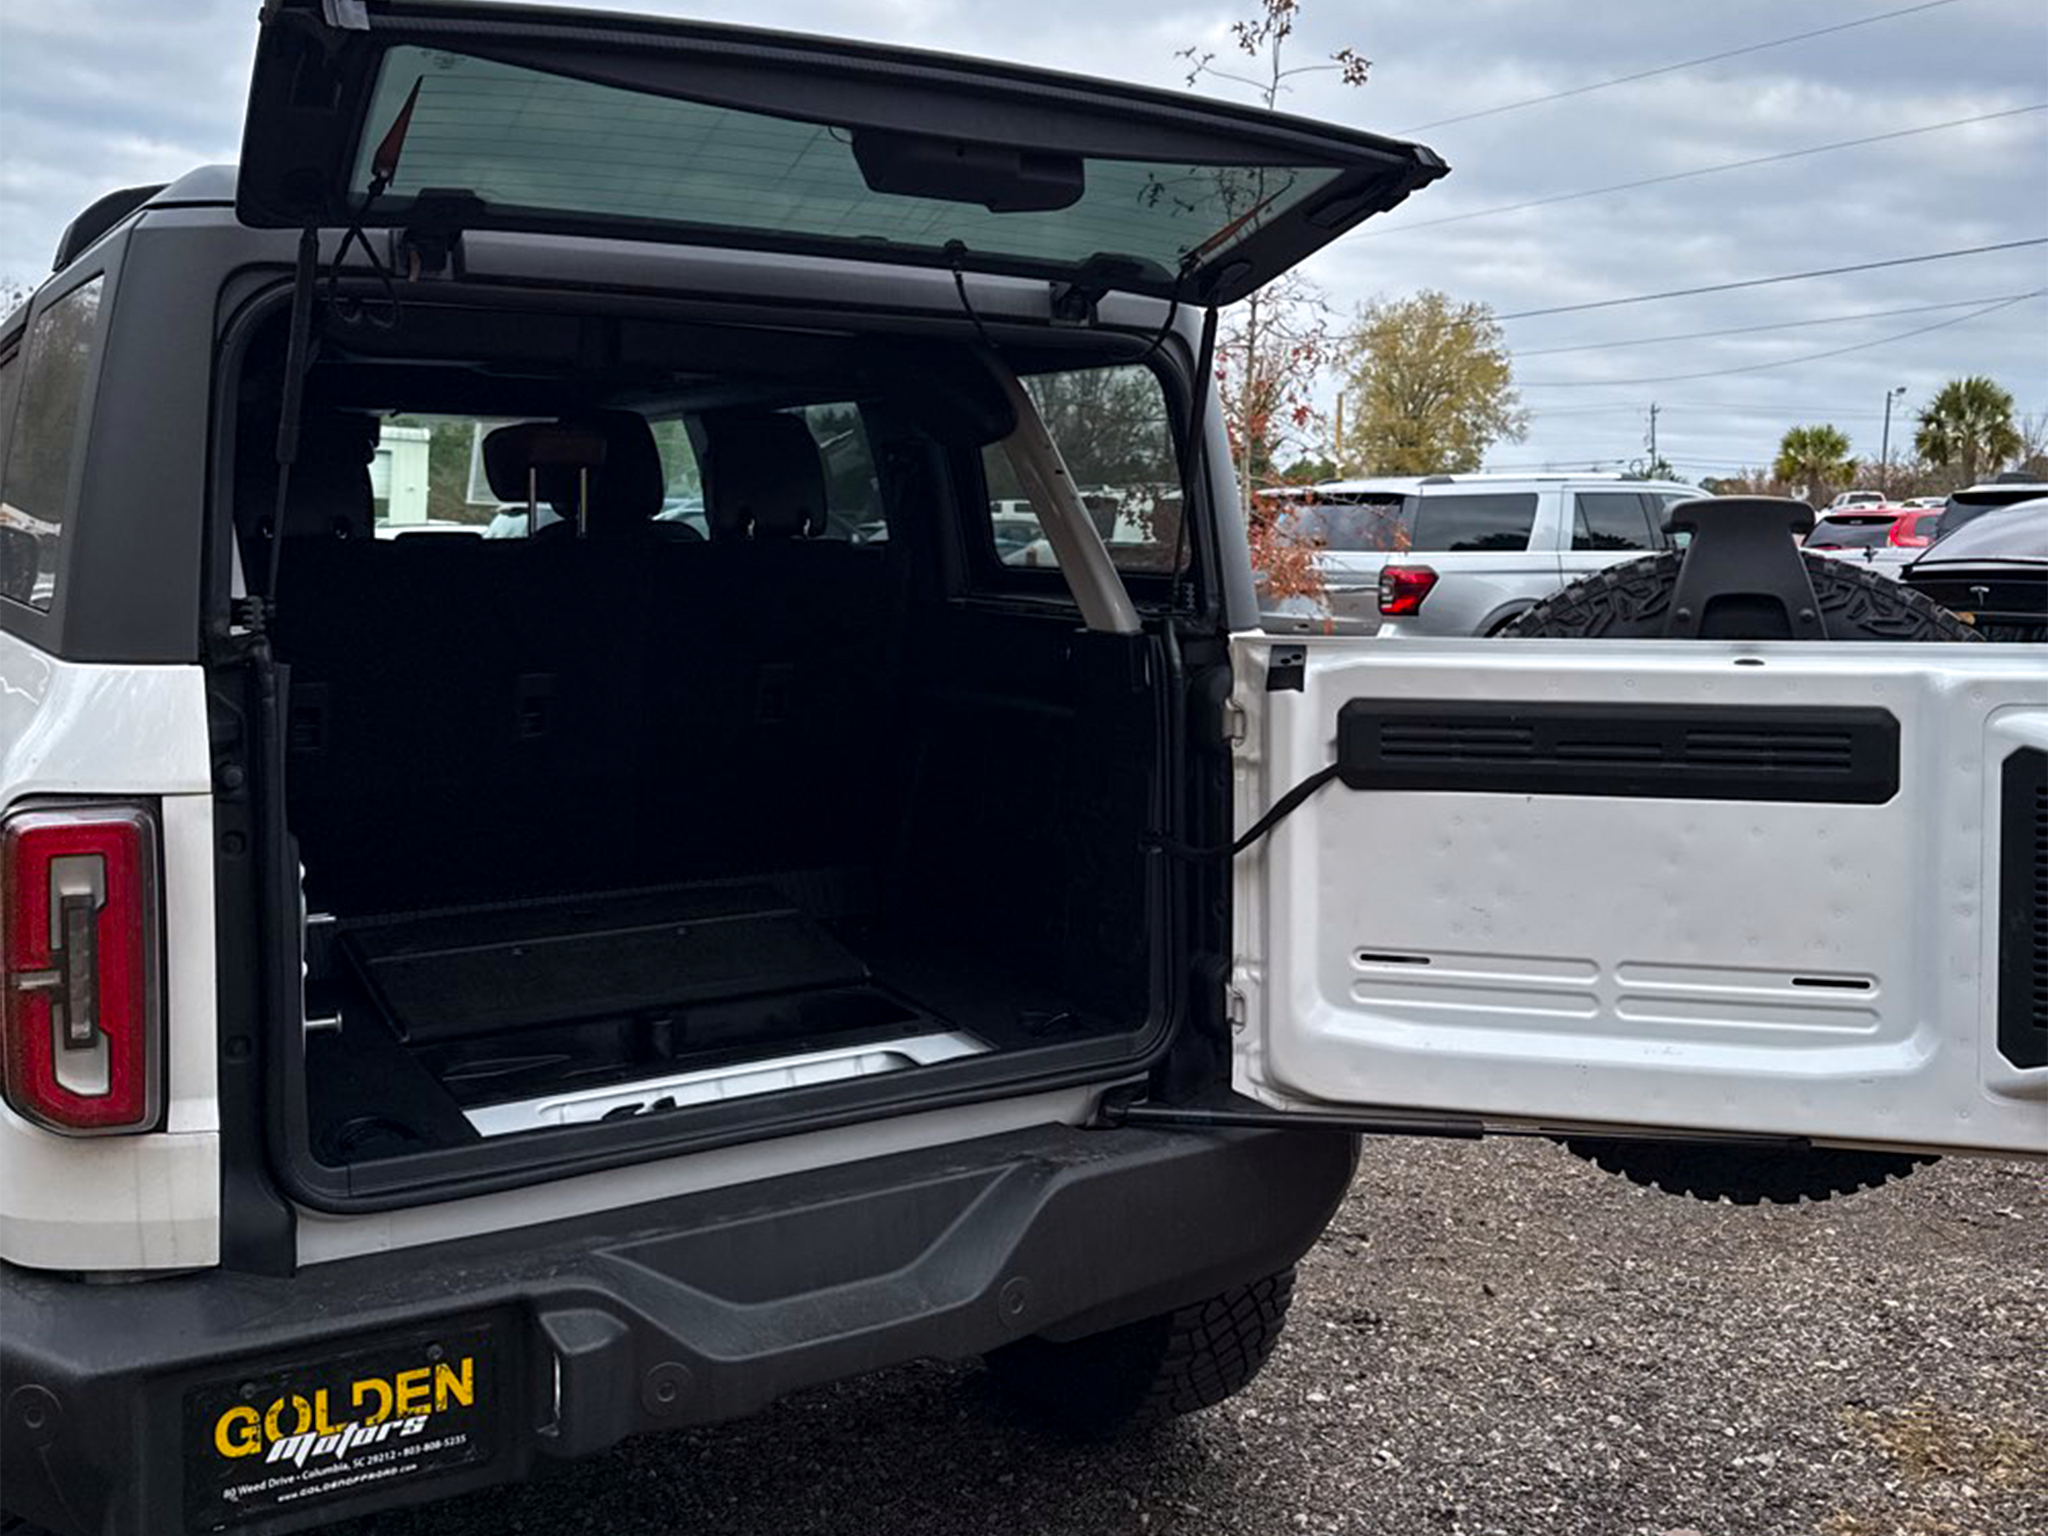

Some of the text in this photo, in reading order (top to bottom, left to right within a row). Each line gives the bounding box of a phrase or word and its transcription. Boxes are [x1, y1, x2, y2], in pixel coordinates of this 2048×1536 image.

[214, 1357, 474, 1458] GOLDEN
[238, 1480, 267, 1496] Weed
[268, 1475, 295, 1489] Drive
[352, 1456, 365, 1468] SC
[366, 1450, 396, 1466] 29212
